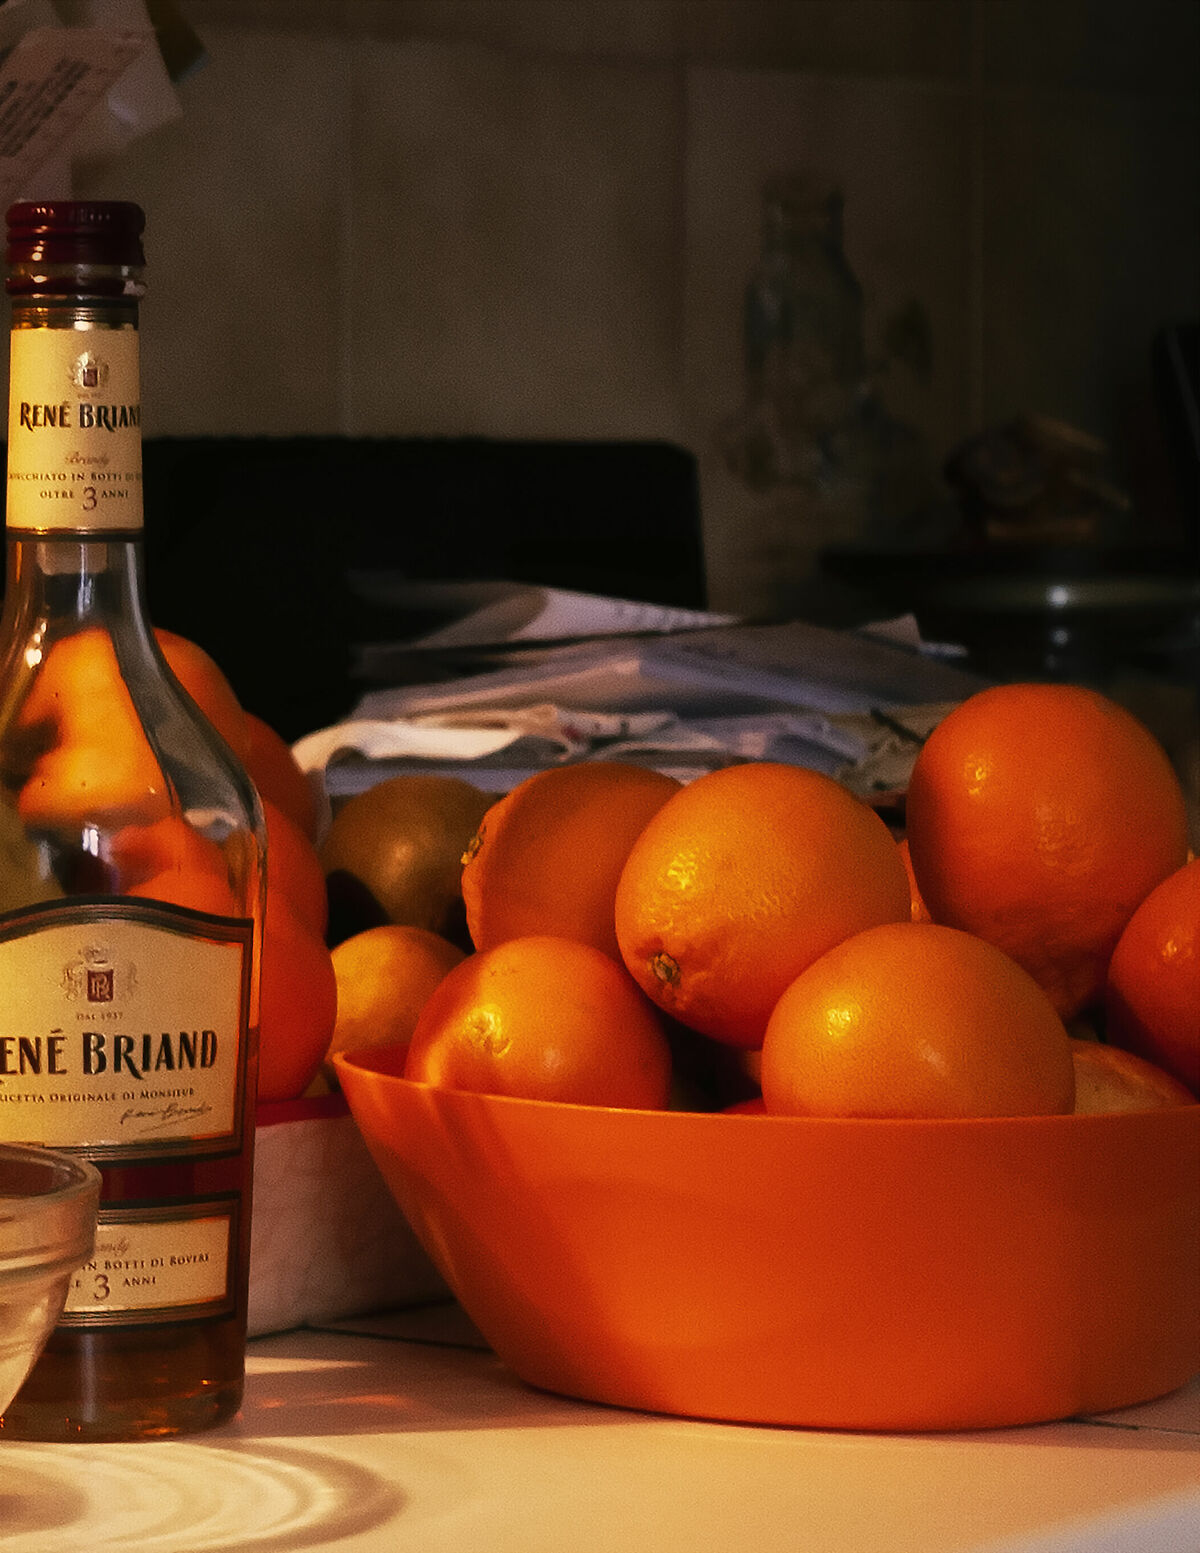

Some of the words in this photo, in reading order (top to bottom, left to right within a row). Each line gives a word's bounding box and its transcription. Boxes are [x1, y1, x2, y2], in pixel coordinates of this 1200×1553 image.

[20, 401, 71, 432] RENÉ
[79, 403, 143, 432] BRIAN
[71, 473, 85, 483] IN
[91, 472, 122, 482] BOTTI
[40, 489, 74, 499] OLTRE
[82, 486, 98, 511] 3
[101, 489, 129, 499] ANNI
[76, 1013, 96, 1021] DAL
[82, 1030, 218, 1080] BRIAND
[123, 1092, 136, 1101] DI
[104, 1259, 145, 1271] BOTTI
[150, 1258, 164, 1268] DI
[93, 1273, 111, 1300] 3
[122, 1276, 157, 1287] ANNI
